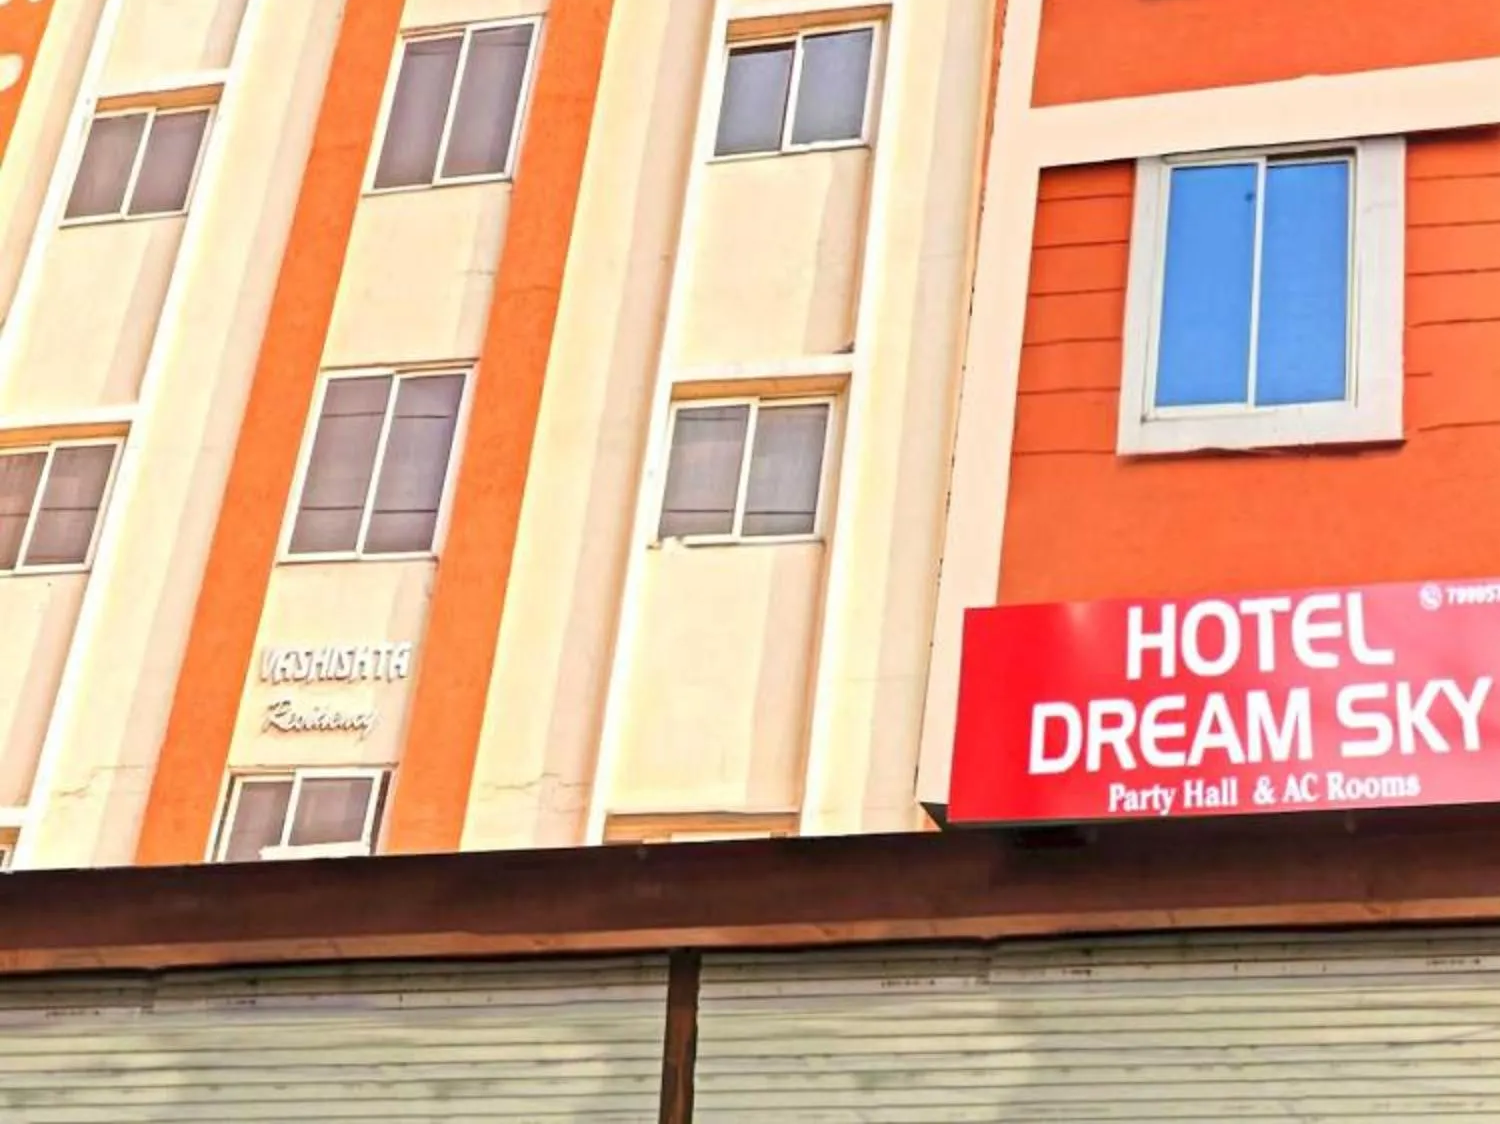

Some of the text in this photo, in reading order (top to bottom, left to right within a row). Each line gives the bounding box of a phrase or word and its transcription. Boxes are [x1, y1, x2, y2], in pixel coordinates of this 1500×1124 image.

[1125, 591, 1395, 680] HOTEL
[1028, 676, 1494, 776] DREAM SKY
[1108, 772, 1422, 816] Party Hall & AC Rooms
